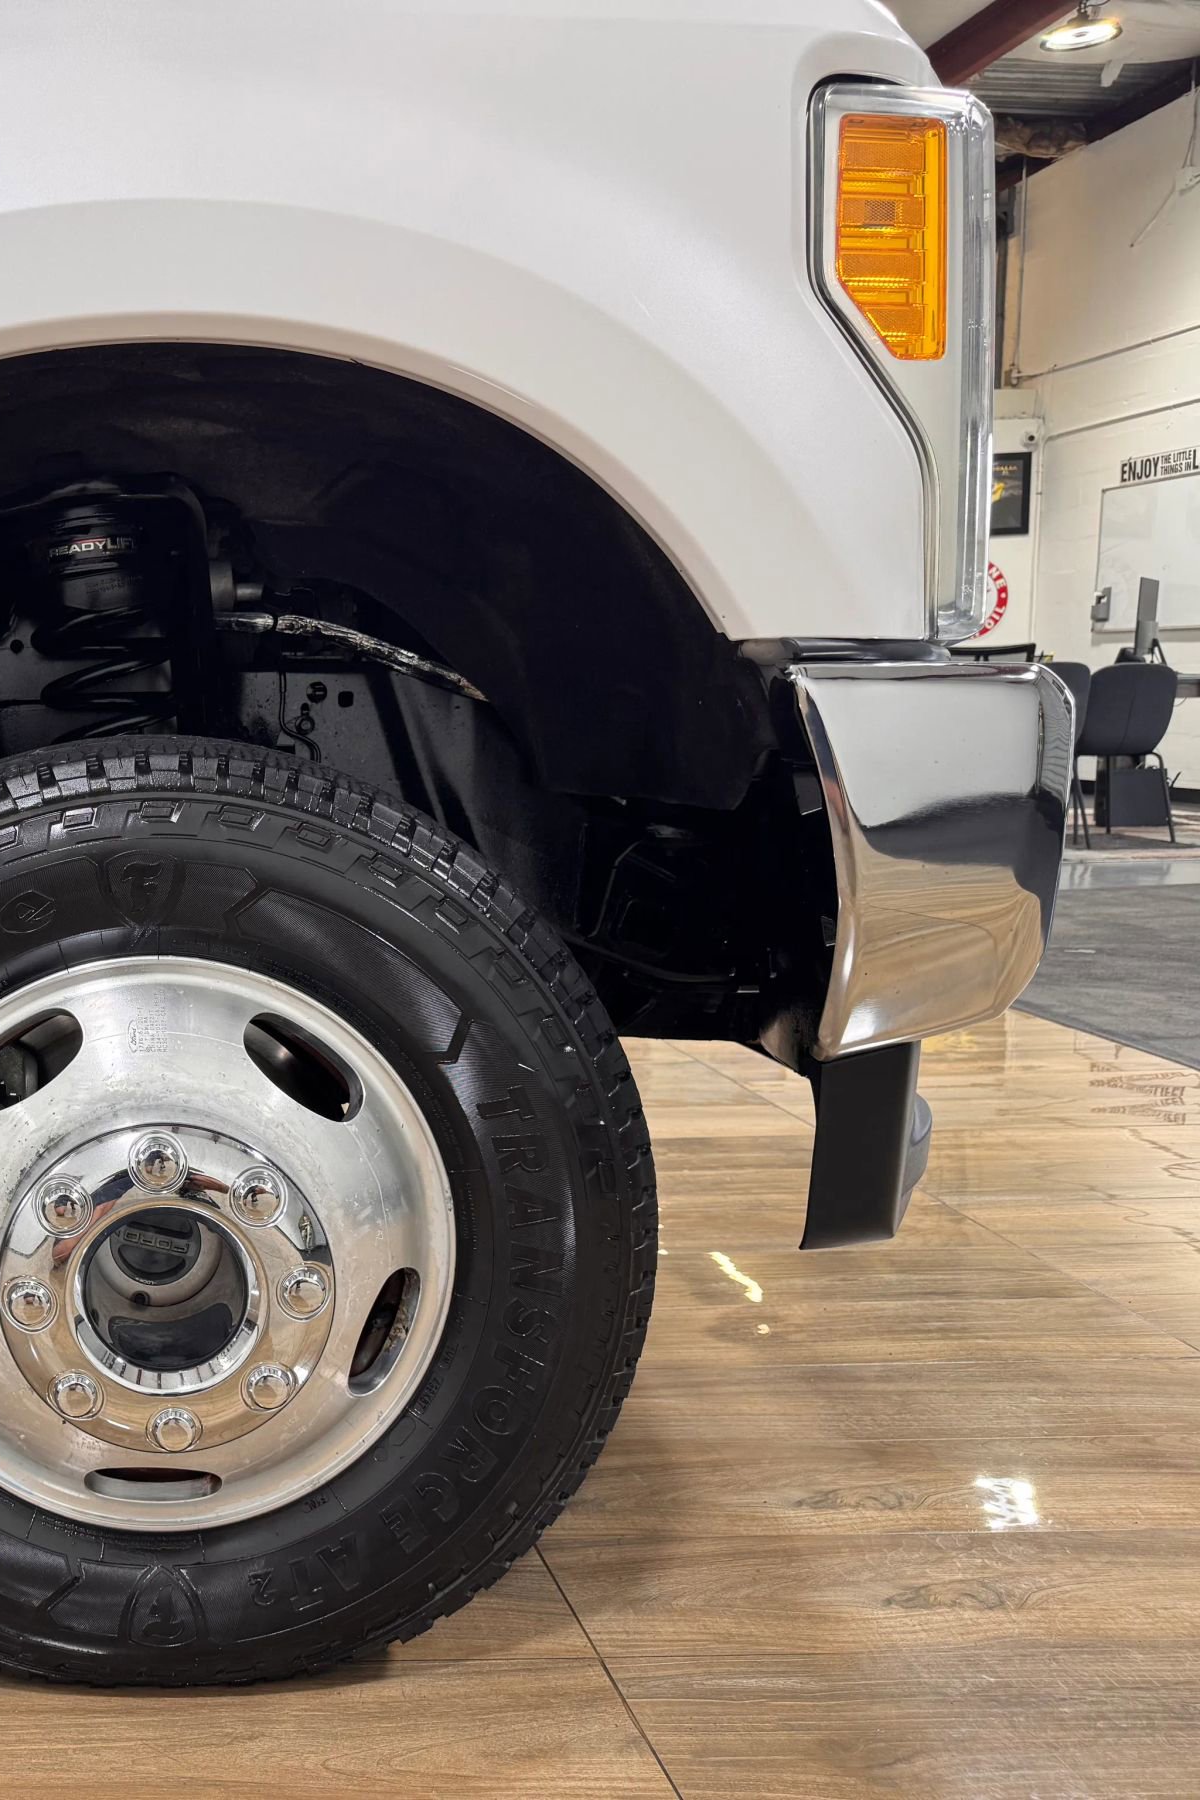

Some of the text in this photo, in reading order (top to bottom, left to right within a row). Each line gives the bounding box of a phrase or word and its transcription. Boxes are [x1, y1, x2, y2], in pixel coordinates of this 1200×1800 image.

[1160, 450, 1192, 465] THE LITTLE
[1160, 460, 1192, 476] THINGS IN
[1120, 456, 1160, 483] ENJOY
[124, 1231, 189, 1254] FORD
[247, 1083, 562, 1612] TRANSFORCE AT2
